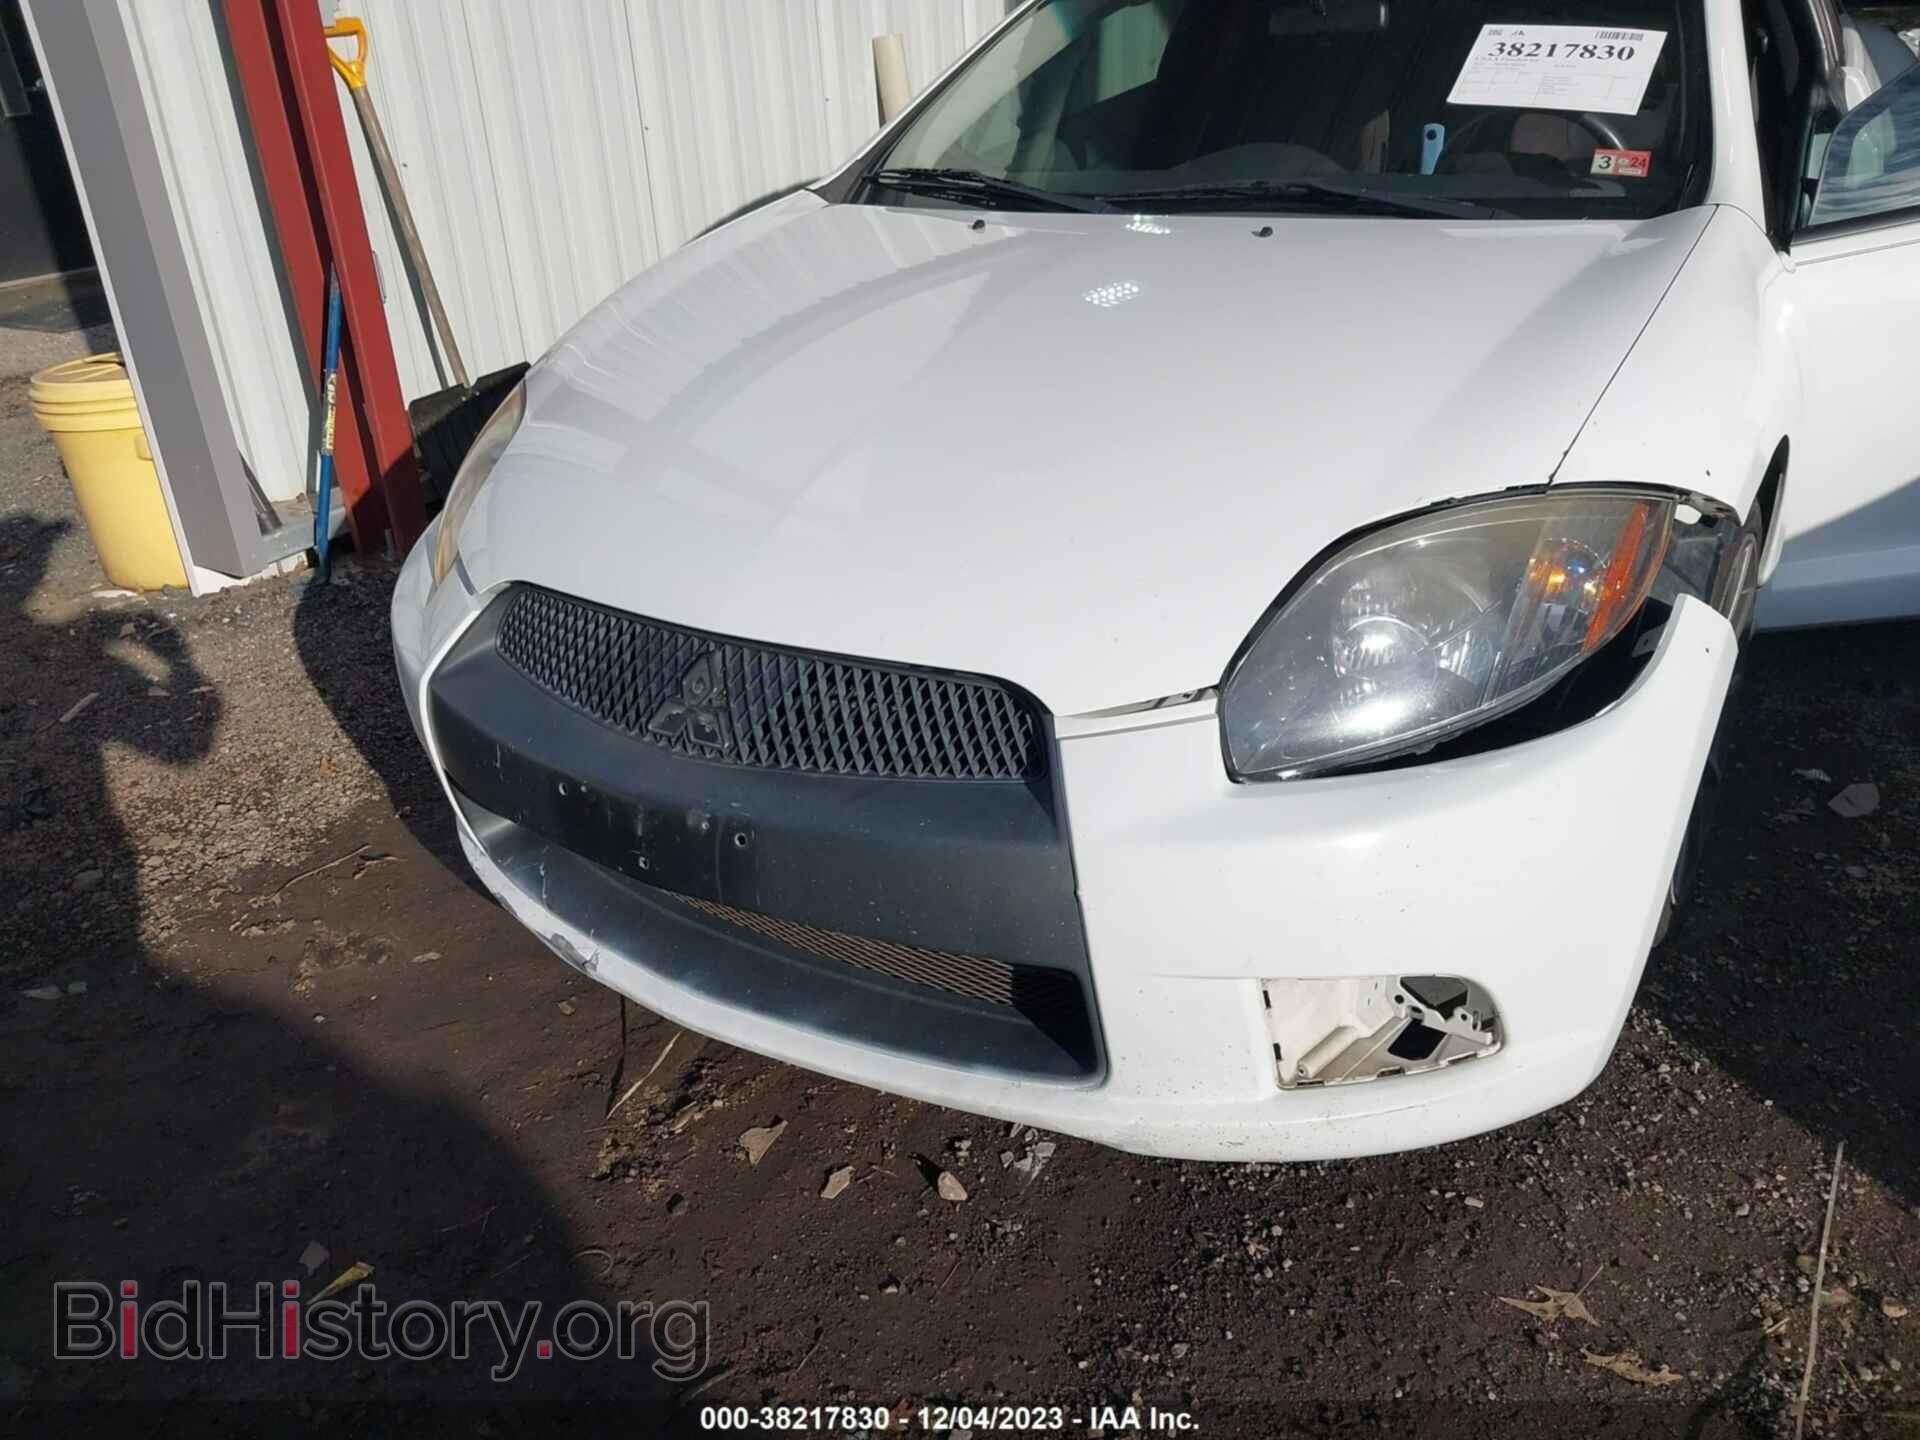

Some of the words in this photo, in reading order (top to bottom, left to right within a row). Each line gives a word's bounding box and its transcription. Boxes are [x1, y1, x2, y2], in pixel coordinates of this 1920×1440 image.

[1488, 42, 1635, 62] 38217830
[1598, 155, 1612, 170] 3
[1631, 156, 1648, 168] 24
